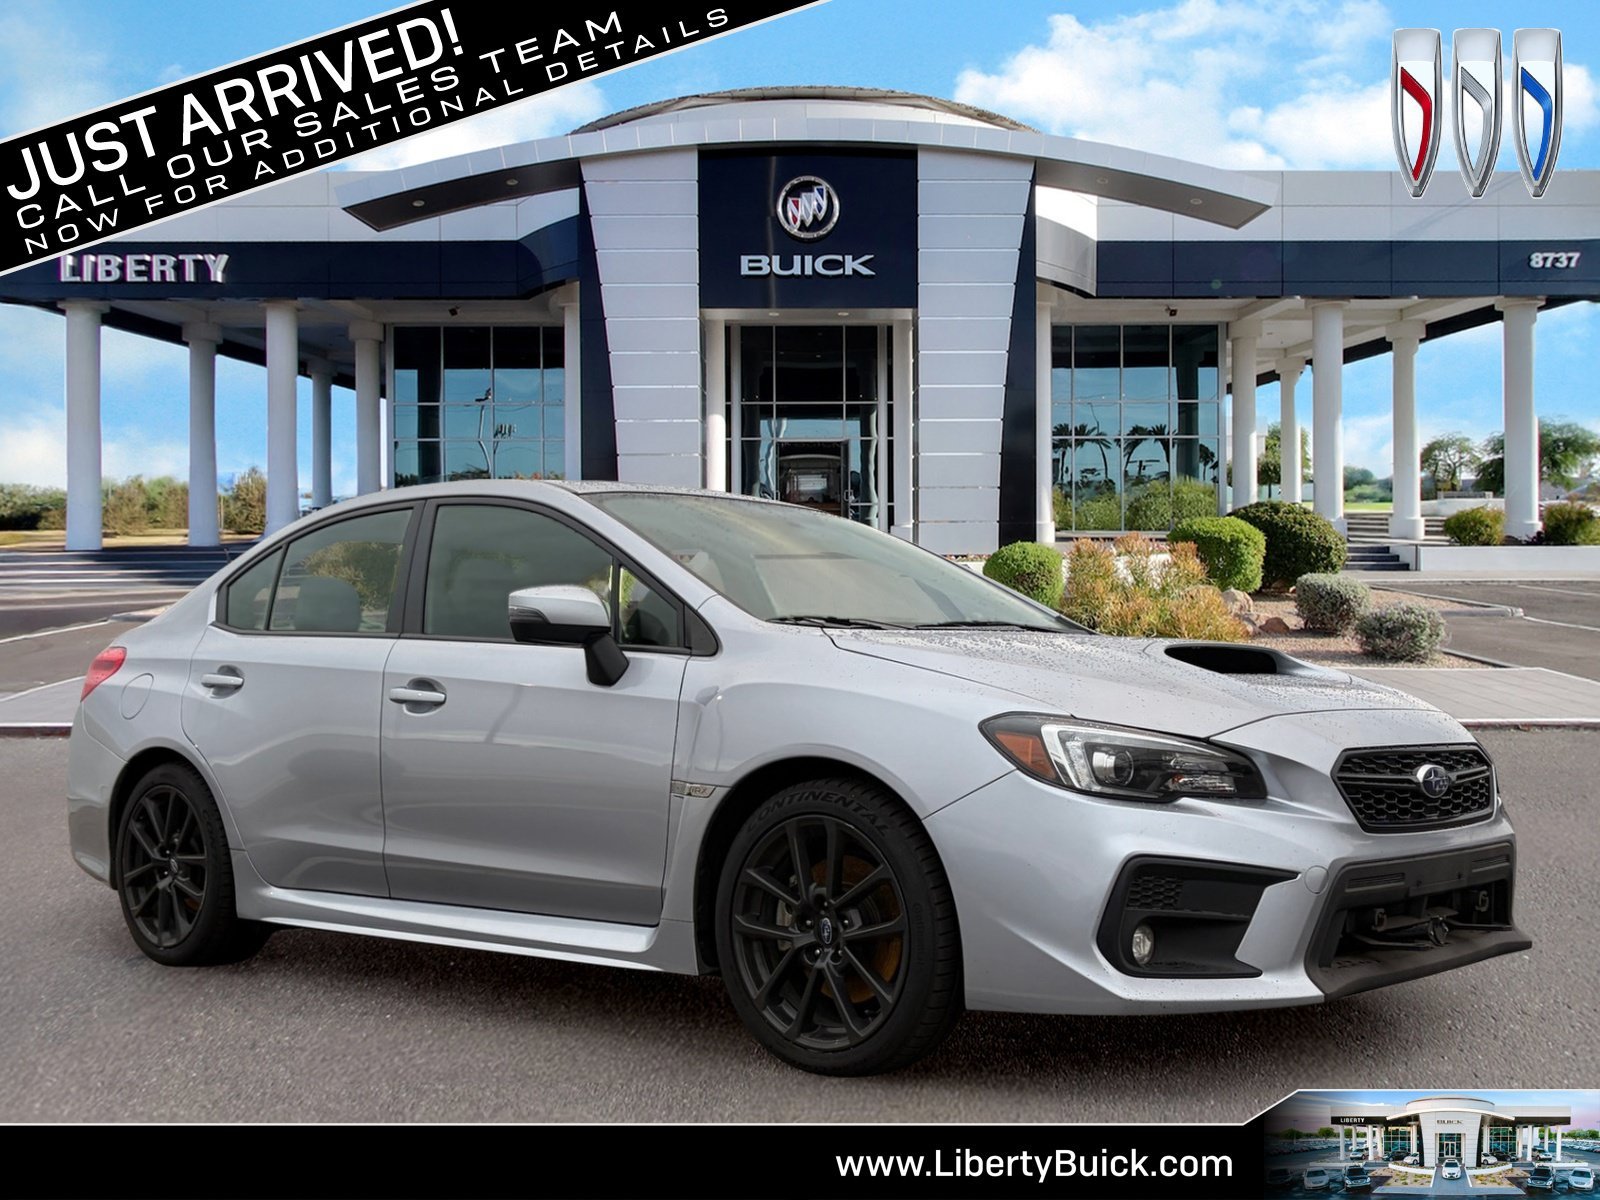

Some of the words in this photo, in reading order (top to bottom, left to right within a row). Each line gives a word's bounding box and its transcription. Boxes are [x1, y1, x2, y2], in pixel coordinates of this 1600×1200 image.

[58, 253, 229, 284] LIBERTY
[740, 254, 876, 276] BUICK
[1529, 251, 1581, 269] 8737
